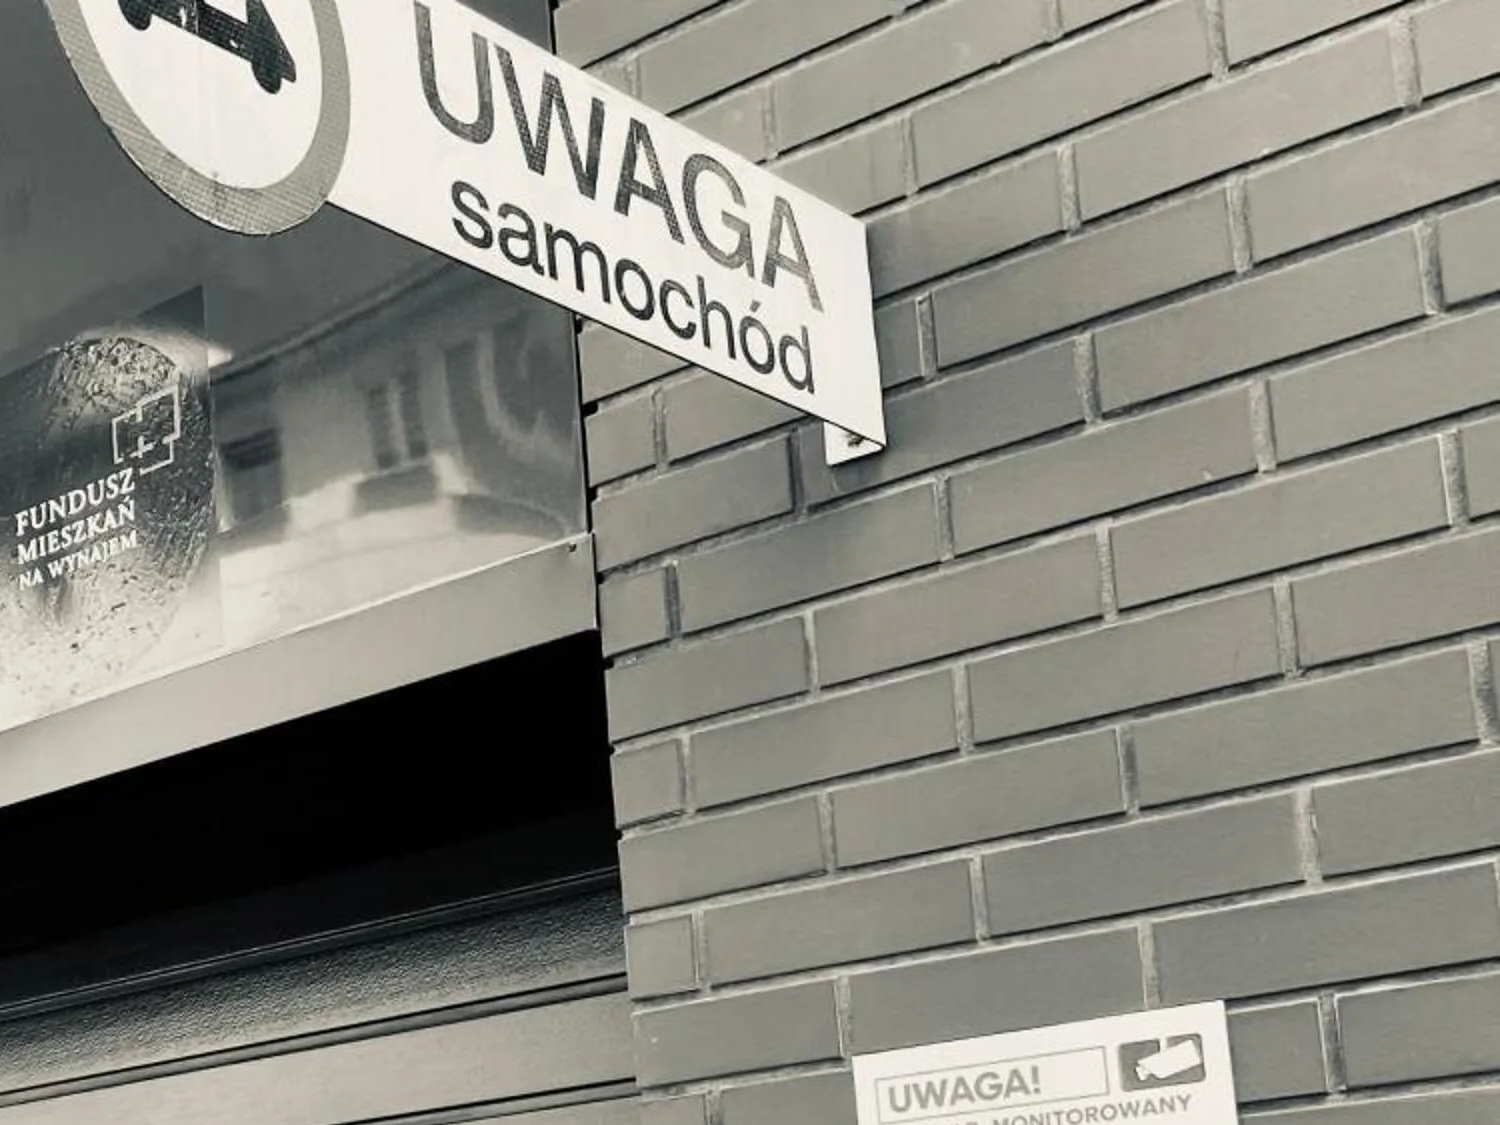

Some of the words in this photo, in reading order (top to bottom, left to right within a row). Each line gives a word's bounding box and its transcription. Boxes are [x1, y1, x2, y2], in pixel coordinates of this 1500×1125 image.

[413, 0, 825, 312] UWAGA
[451, 179, 816, 396] samochód
[15, 467, 135, 536] FUNDUSZ
[17, 495, 135, 565] MIESZKAŃ
[20, 567, 43, 590] NA
[47, 529, 138, 579] WYNAJEM
[887, 1065, 1041, 1114] UWAGA!
